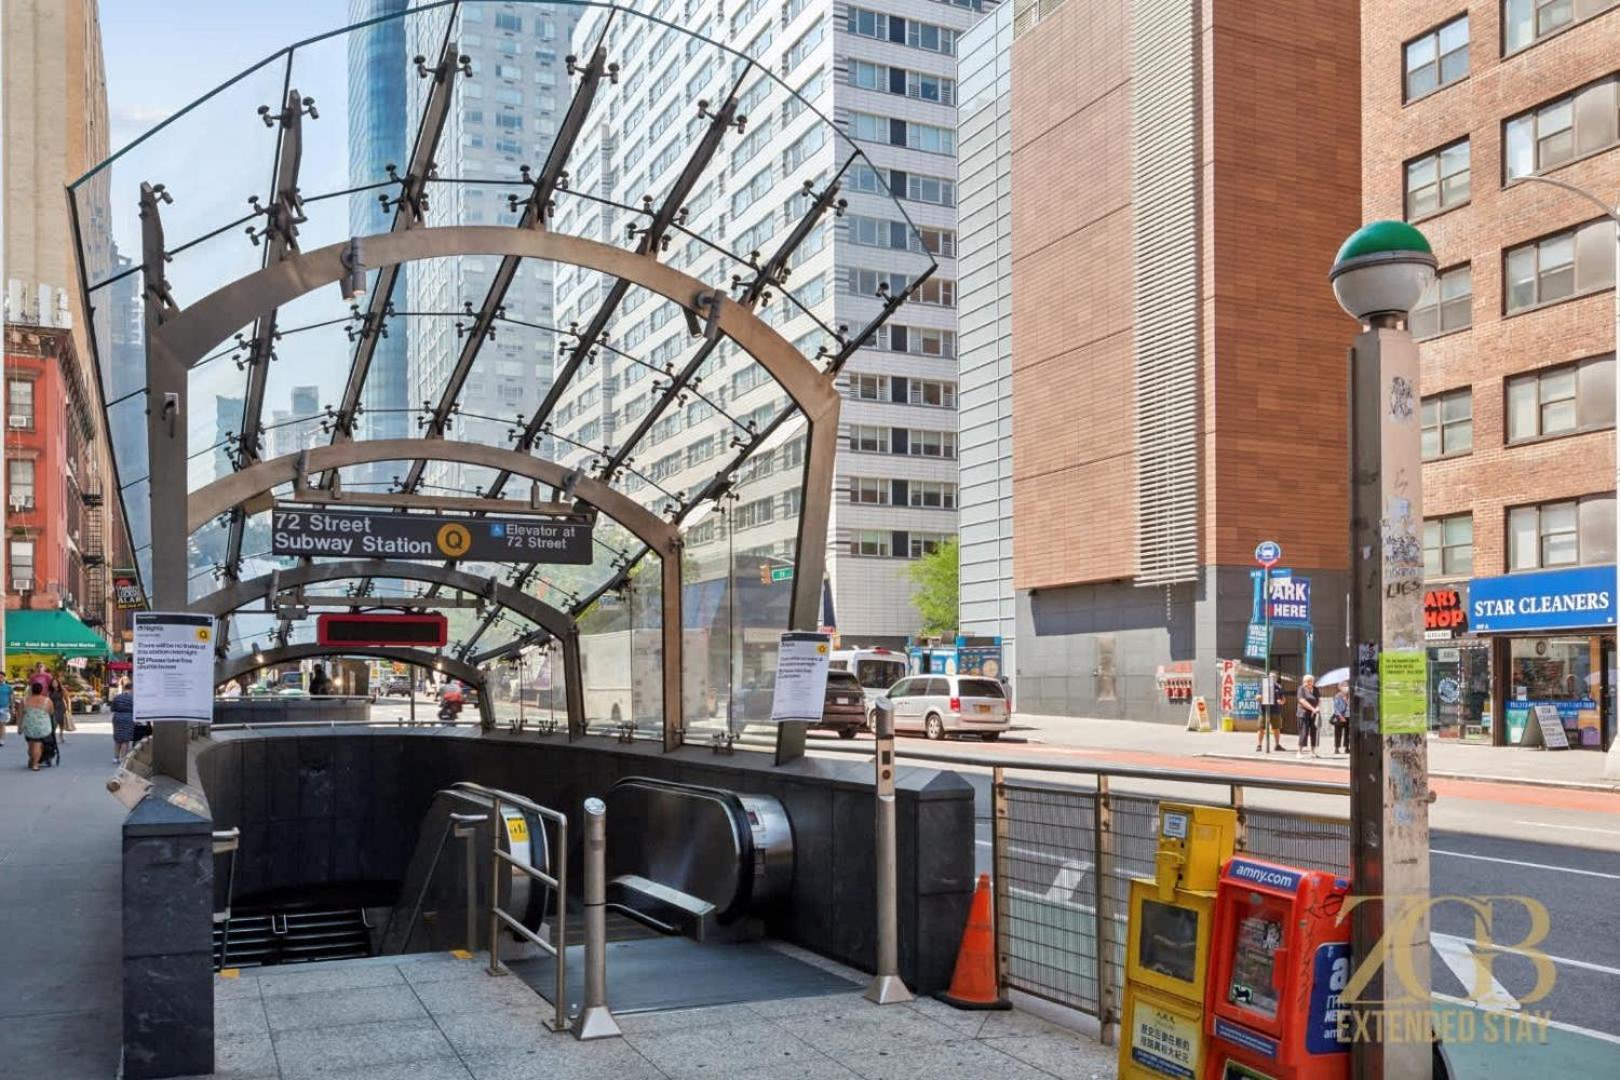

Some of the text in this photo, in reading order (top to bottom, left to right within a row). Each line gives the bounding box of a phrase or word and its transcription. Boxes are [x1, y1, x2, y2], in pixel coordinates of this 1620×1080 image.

[274, 513, 371, 533] 72 Street
[506, 524, 575, 538] Elevator at
[274, 533, 432, 554] Subway Station
[446, 530, 463, 550] Q
[507, 536, 567, 550] 72 Street
[1424, 591, 1457, 607] ARS
[1474, 591, 1610, 617] STAR CLEANERS
[1273, 603, 1307, 617] HERE
[1424, 609, 1464, 628] HOP
[1223, 661, 1233, 710] PARK
[1236, 864, 1293, 887] amny.com
